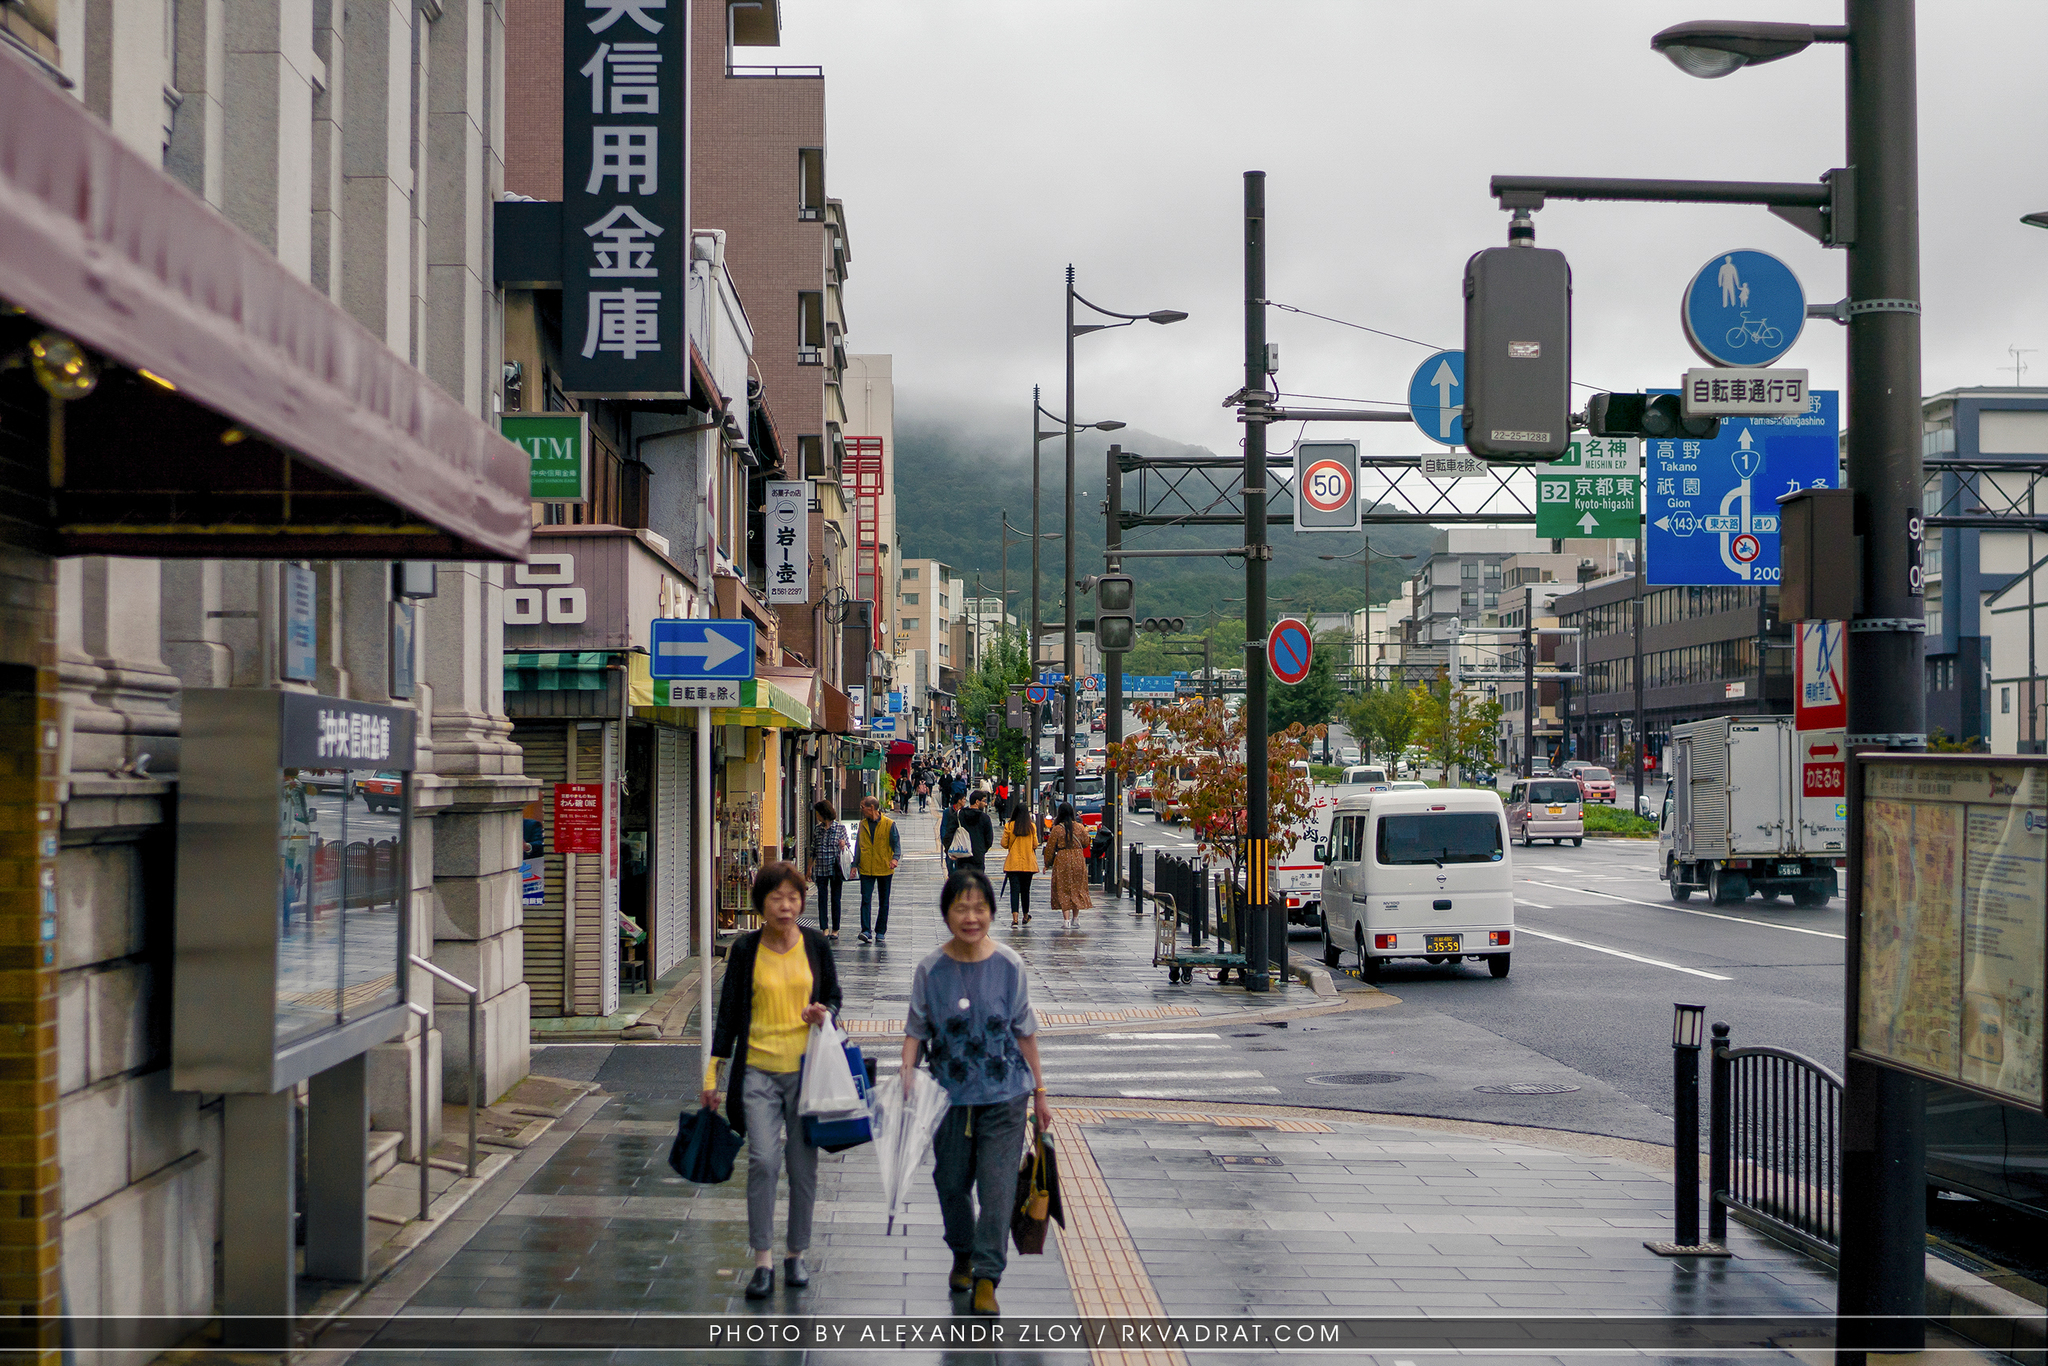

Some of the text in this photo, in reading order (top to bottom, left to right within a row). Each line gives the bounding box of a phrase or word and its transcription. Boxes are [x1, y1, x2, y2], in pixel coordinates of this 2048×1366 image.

[1694, 379, 1802, 403] 自転車通行可
[1493, 431, 1548, 441] 22-25-1288
[514, 437, 574, 460] TM
[1585, 439, 1627, 457] 名神
[1657, 441, 1700, 459] 高野
[1426, 459, 1483, 472] 自転車を除く
[1585, 460, 1627, 469] MEISHIN EXP
[1660, 462, 1697, 472] Takano
[1741, 454, 1748, 469] 1
[1315, 475, 1341, 496] 50
[1543, 484, 1568, 500] 32
[1575, 477, 1634, 496] 京都東
[1657, 478, 1700, 496] 祇園
[1575, 498, 1634, 511] Kyoto-higashi
[1668, 498, 1690, 508] Gion
[1673, 517, 1693, 530] 143
[1710, 519, 1772, 530] 東大路 通り
[673, 687, 736, 701] 自転車を除く
[1806, 768, 1841, 788] わたるな
[1303, 826, 1328, 843] 肉の
[1433, 942, 1459, 951] 35-59
